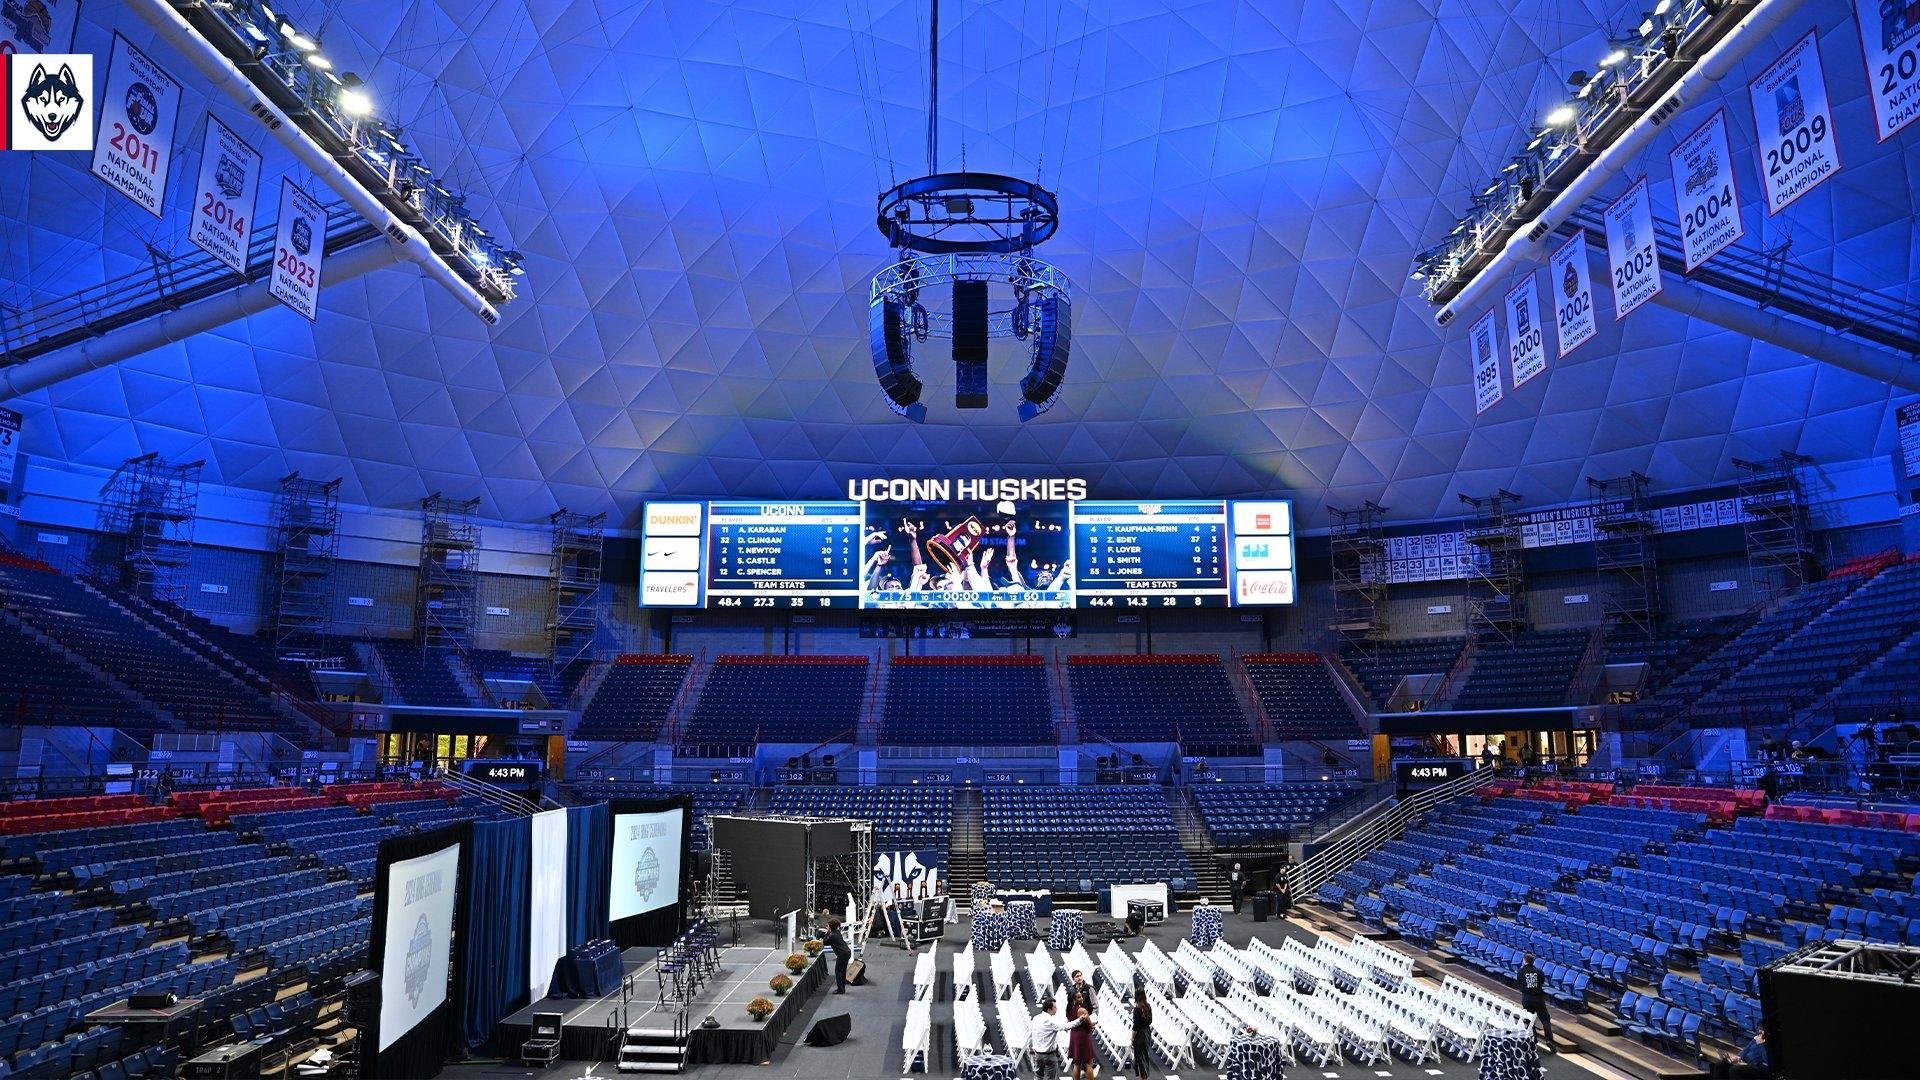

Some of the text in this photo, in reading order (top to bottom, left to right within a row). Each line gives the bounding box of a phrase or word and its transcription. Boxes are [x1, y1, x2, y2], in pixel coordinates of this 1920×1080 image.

[128, 46, 151, 71] UConn
[129, 62, 164, 97] Basketball
[1754, 64, 1777, 90] UConn
[1766, 60, 1802, 93] Basketball
[109, 122, 158, 174] 2011
[1767, 114, 1826, 177] 2009
[107, 150, 154, 191] NATIONAL
[1777, 149, 1824, 189] NATIONAL
[101, 164, 155, 208] CHAMPIONS
[1776, 160, 1831, 206] CHAMPIONS
[202, 192, 245, 239] 2014
[1684, 184, 1733, 238] 2004
[202, 219, 239, 252] NATIONAL
[1692, 216, 1731, 248] NATIONAL
[197, 231, 241, 267] CHAMPIONS
[1691, 228, 1736, 263] CHAMPIONS
[277, 247, 315, 289] 2023
[1615, 244, 1653, 289] 2003
[280, 273, 310, 301] NATIONAL
[1621, 273, 1652, 300] NATIONAL
[275, 285, 311, 315] CHAMPIONS
[1620, 283, 1657, 313] CHAMPIONS
[1560, 291, 1590, 328] 2002
[1564, 316, 1588, 337] NATIONAL
[1512, 328, 1540, 363] 2000
[1563, 325, 1592, 351] CHAMPIONS
[1517, 353, 1539, 370] NATIONAL
[1476, 361, 1497, 389] 1995
[1516, 361, 1542, 384] CHAMPIONS
[848, 479, 1087, 501] UCONN HUSKIES
[760, 505, 804, 516] UCONN
[1530, 511, 1560, 523] WOMEN'S
[1562, 507, 1590, 519] HUSKIES
[1683, 506, 1694, 516] 31
[1702, 504, 1713, 513] 14
[1719, 501, 1733, 511] 23
[650, 515, 697, 525] DUNKIN'
[1557, 521, 1571, 531] 20
[1394, 538, 1403, 547] 10
[1408, 537, 1420, 546] 32
[1424, 535, 1437, 544] 50
[1441, 534, 1453, 543] 33
[1393, 561, 1406, 570] 24
[1409, 561, 1422, 569] 33
[646, 585, 687, 593] TRAVELERS
[899, 592, 912, 601] 75
[942, 592, 979, 601] 00:00
[1023, 592, 1039, 601] 60
[718, 597, 830, 607] 48.4 27.3 35 18
[1090, 597, 1202, 606] 44.4 14.3 28 8
[138, 769, 159, 779] 122
[182, 769, 194, 777] 122
[488, 767, 525, 778] 4:43 PM
[731, 771, 743, 779] 101
[789, 773, 803, 781] 102
[997, 773, 1010, 781] 104
[1142, 772, 1156, 780] 104
[1411, 768, 1447, 777] 4:43 PM
[1786, 763, 1801, 772] 109
